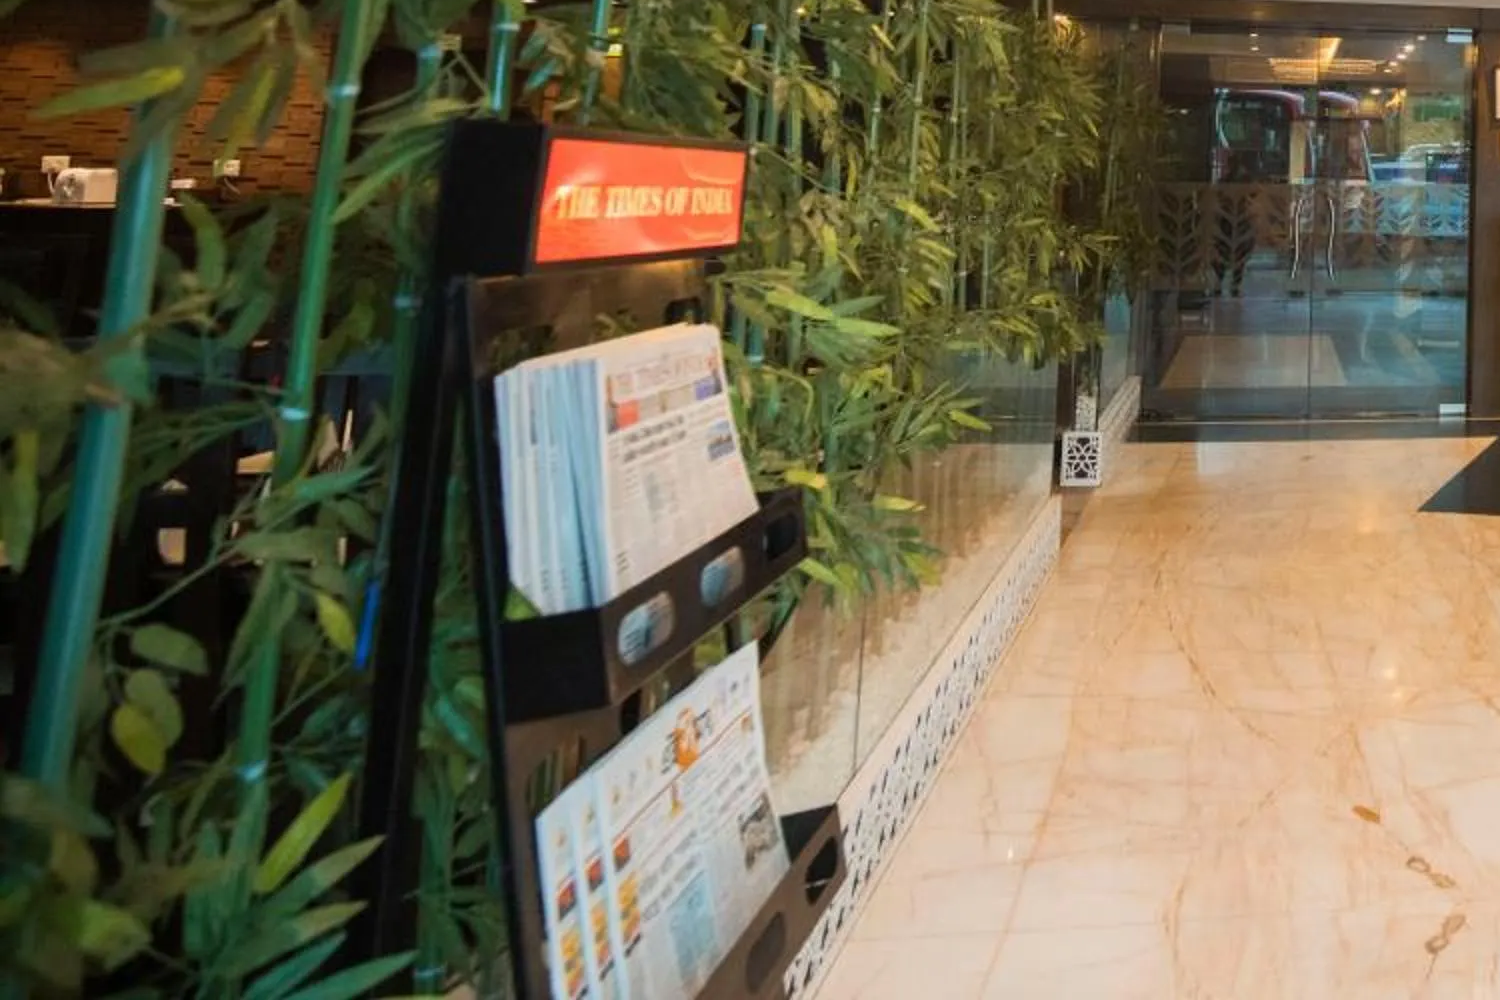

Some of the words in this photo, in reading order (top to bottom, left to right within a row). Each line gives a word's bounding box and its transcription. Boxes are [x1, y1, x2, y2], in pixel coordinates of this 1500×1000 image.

[556, 184, 601, 220] THE
[604, 185, 664, 218] TIMES
[665, 186, 688, 216] OF
